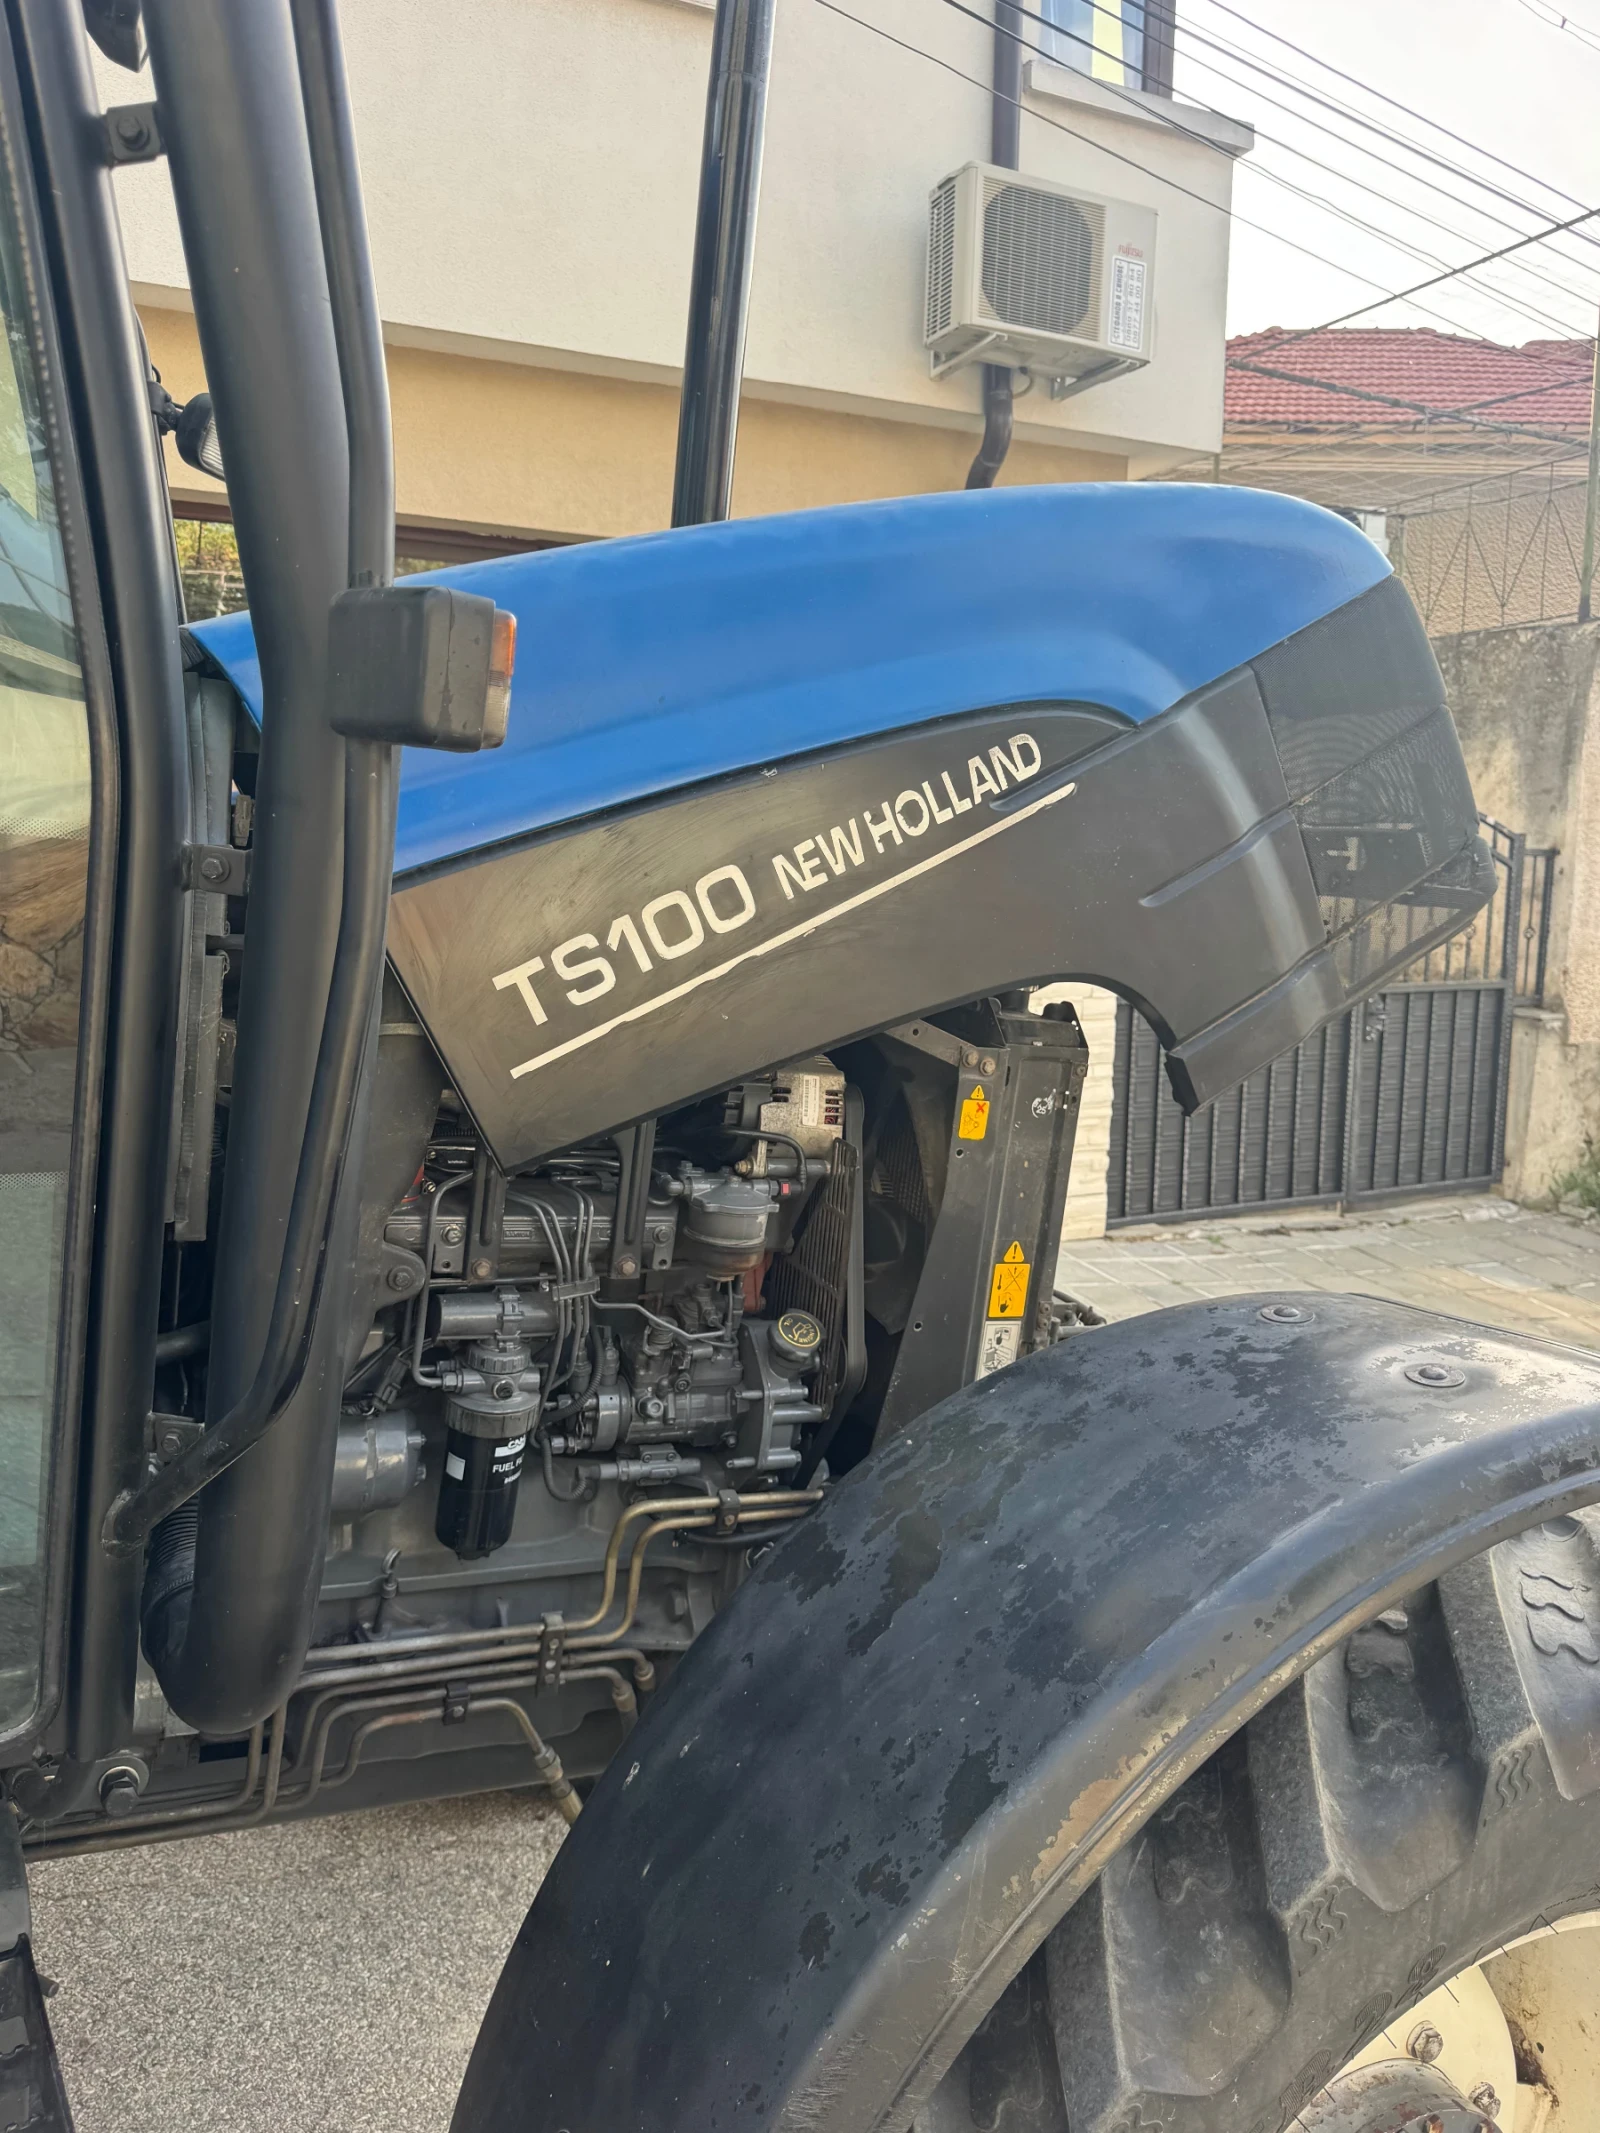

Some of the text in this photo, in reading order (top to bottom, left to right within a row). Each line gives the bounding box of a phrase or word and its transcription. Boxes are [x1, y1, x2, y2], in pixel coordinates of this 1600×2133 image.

[1118, 243, 1143, 258] FUJITSU
[772, 733, 1042, 899] NEW HOLLAND
[492, 864, 757, 1026] TS100
[492, 1461, 516, 1473] FUEL
